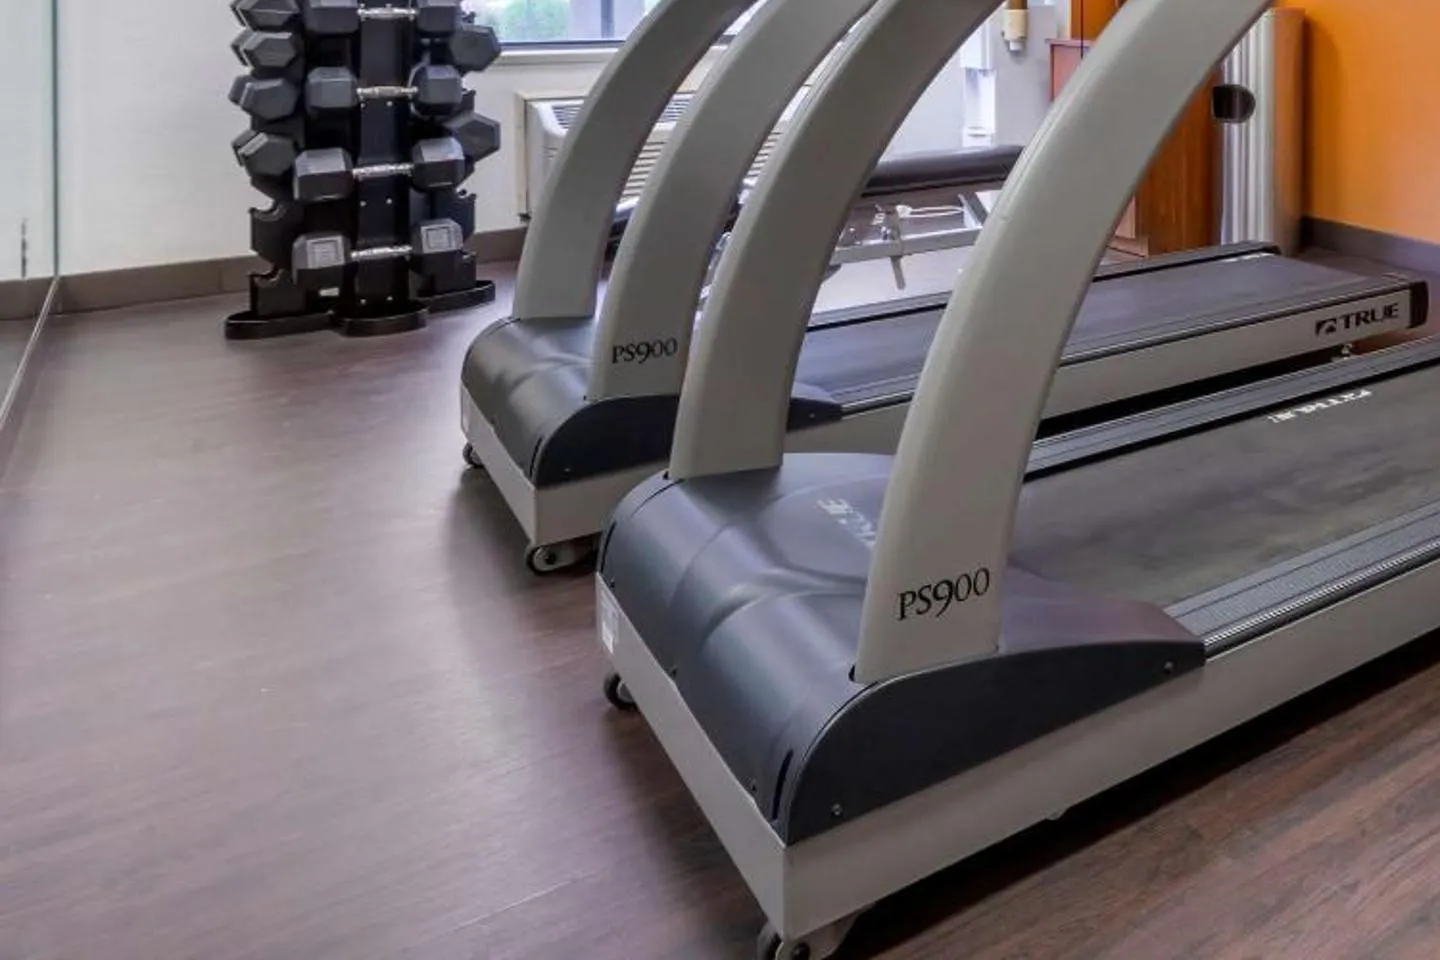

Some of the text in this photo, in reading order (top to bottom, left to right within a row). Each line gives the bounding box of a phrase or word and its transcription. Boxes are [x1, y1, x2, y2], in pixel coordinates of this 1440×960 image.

[1339, 302, 1399, 329] TRUE
[612, 337, 678, 365] PS900
[898, 568, 990, 621] PS900
